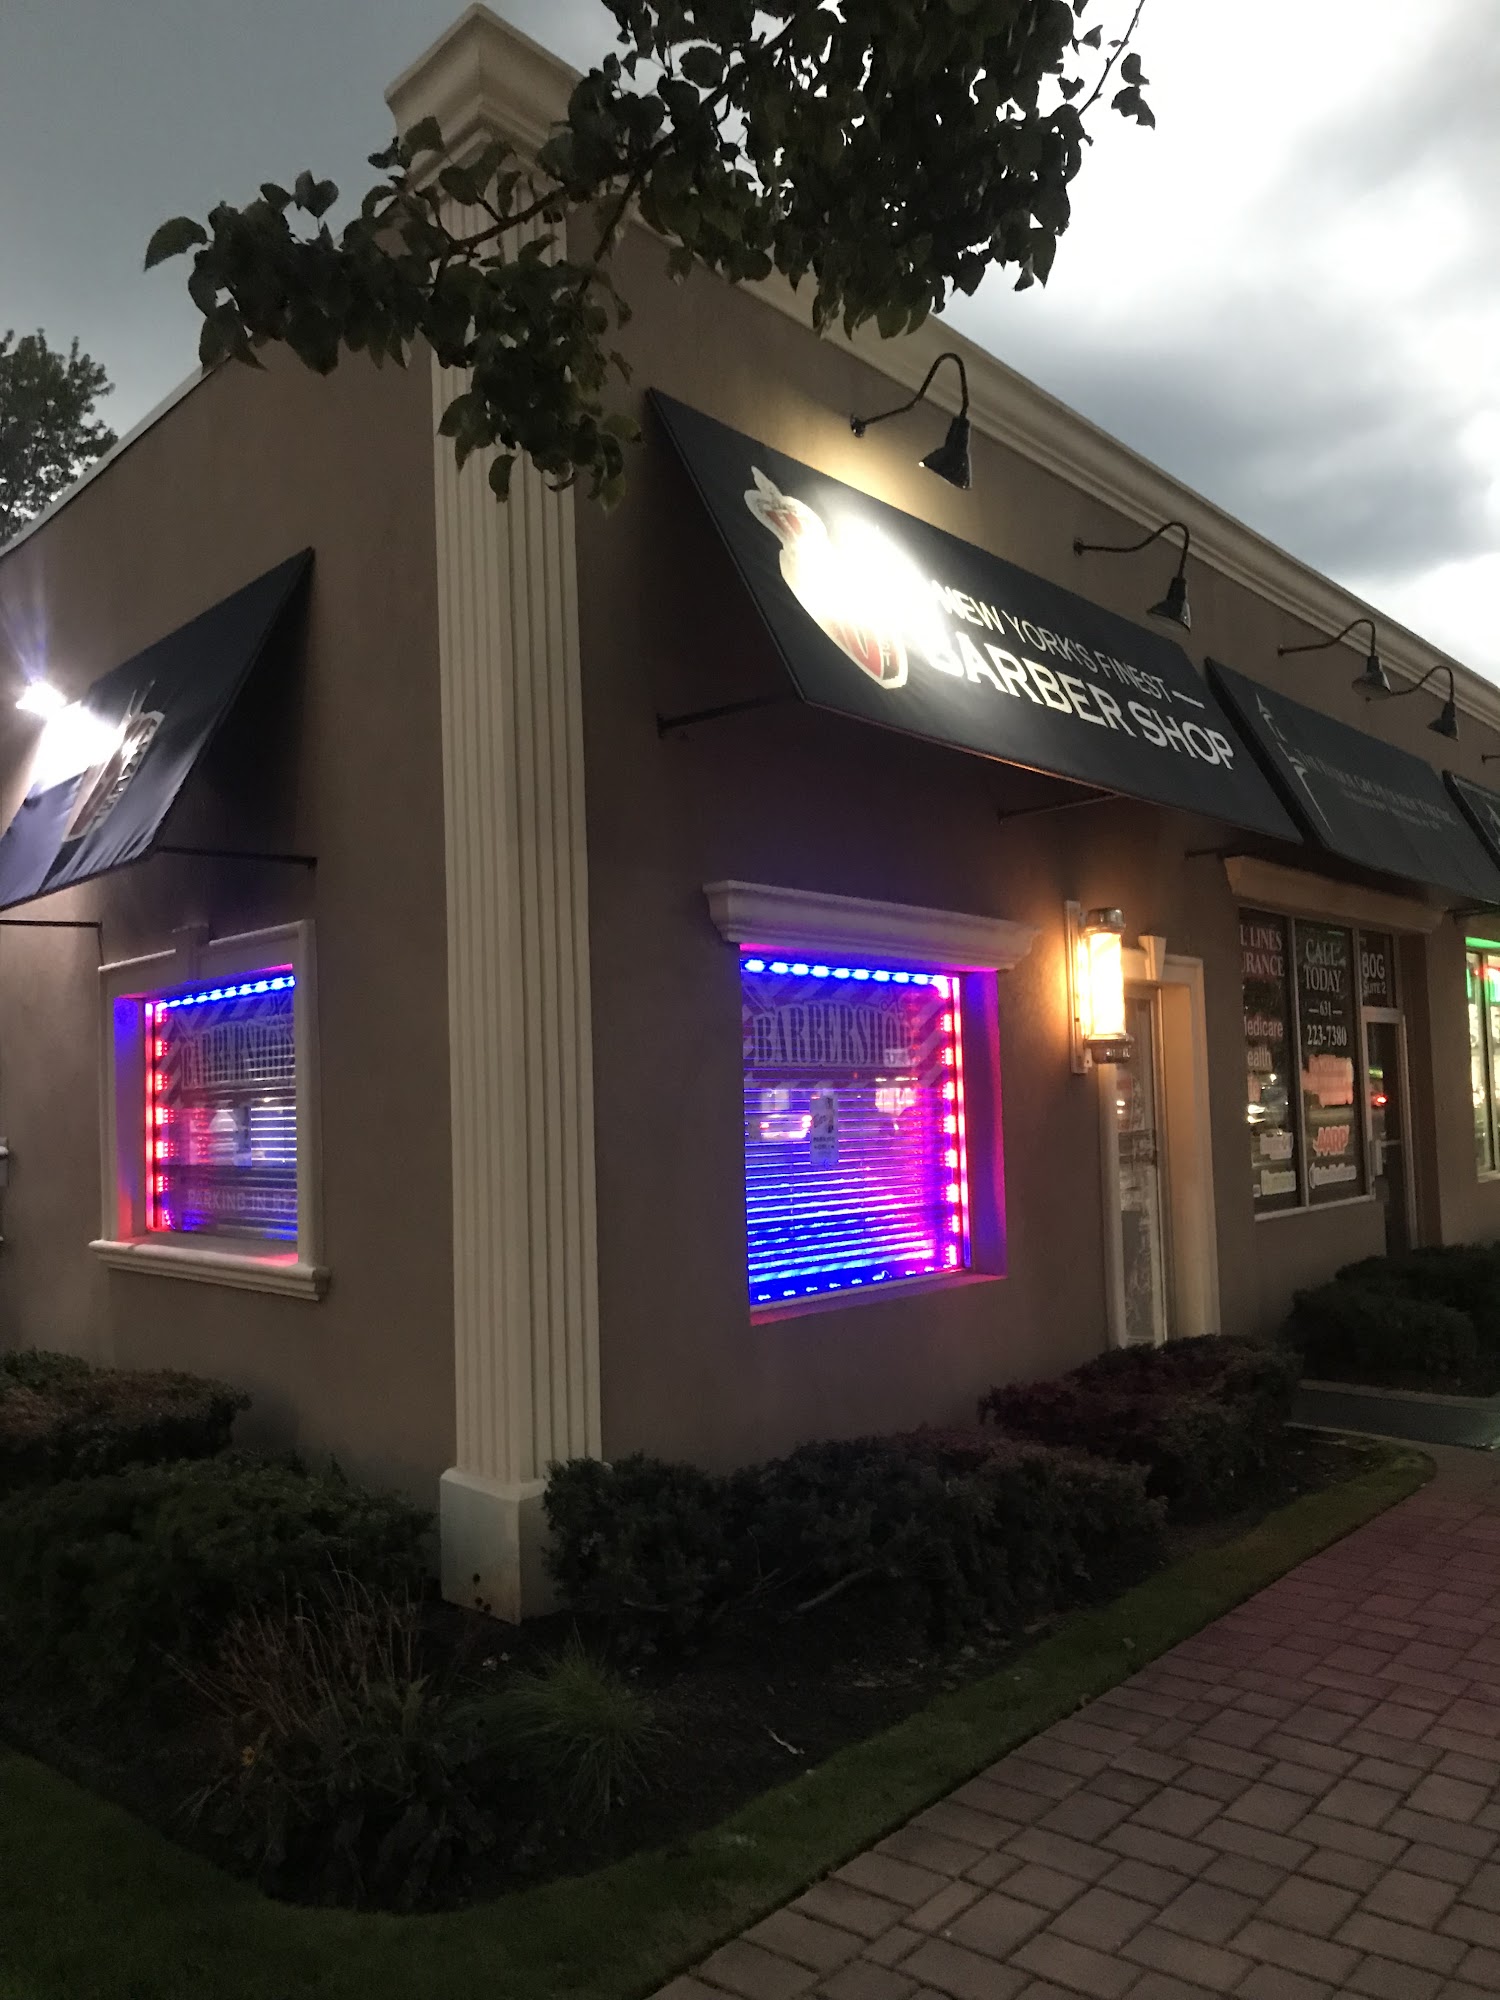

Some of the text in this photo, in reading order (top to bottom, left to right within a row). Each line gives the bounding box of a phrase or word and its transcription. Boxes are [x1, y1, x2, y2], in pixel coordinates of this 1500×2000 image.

[930, 580, 1173, 703] NEW YORK'S FINEST
[922, 626, 1137, 739] BARBER
[1128, 701, 1234, 771] SHOP
[1249, 927, 1283, 951] LINES
[1303, 963, 1342, 993] TODAY
[1381, 981, 1387, 995] 2
[1319, 1000, 1332, 1017] 631
[1306, 1024, 1348, 1047] 223-7380
[188, 1188, 246, 1211] PARKING
